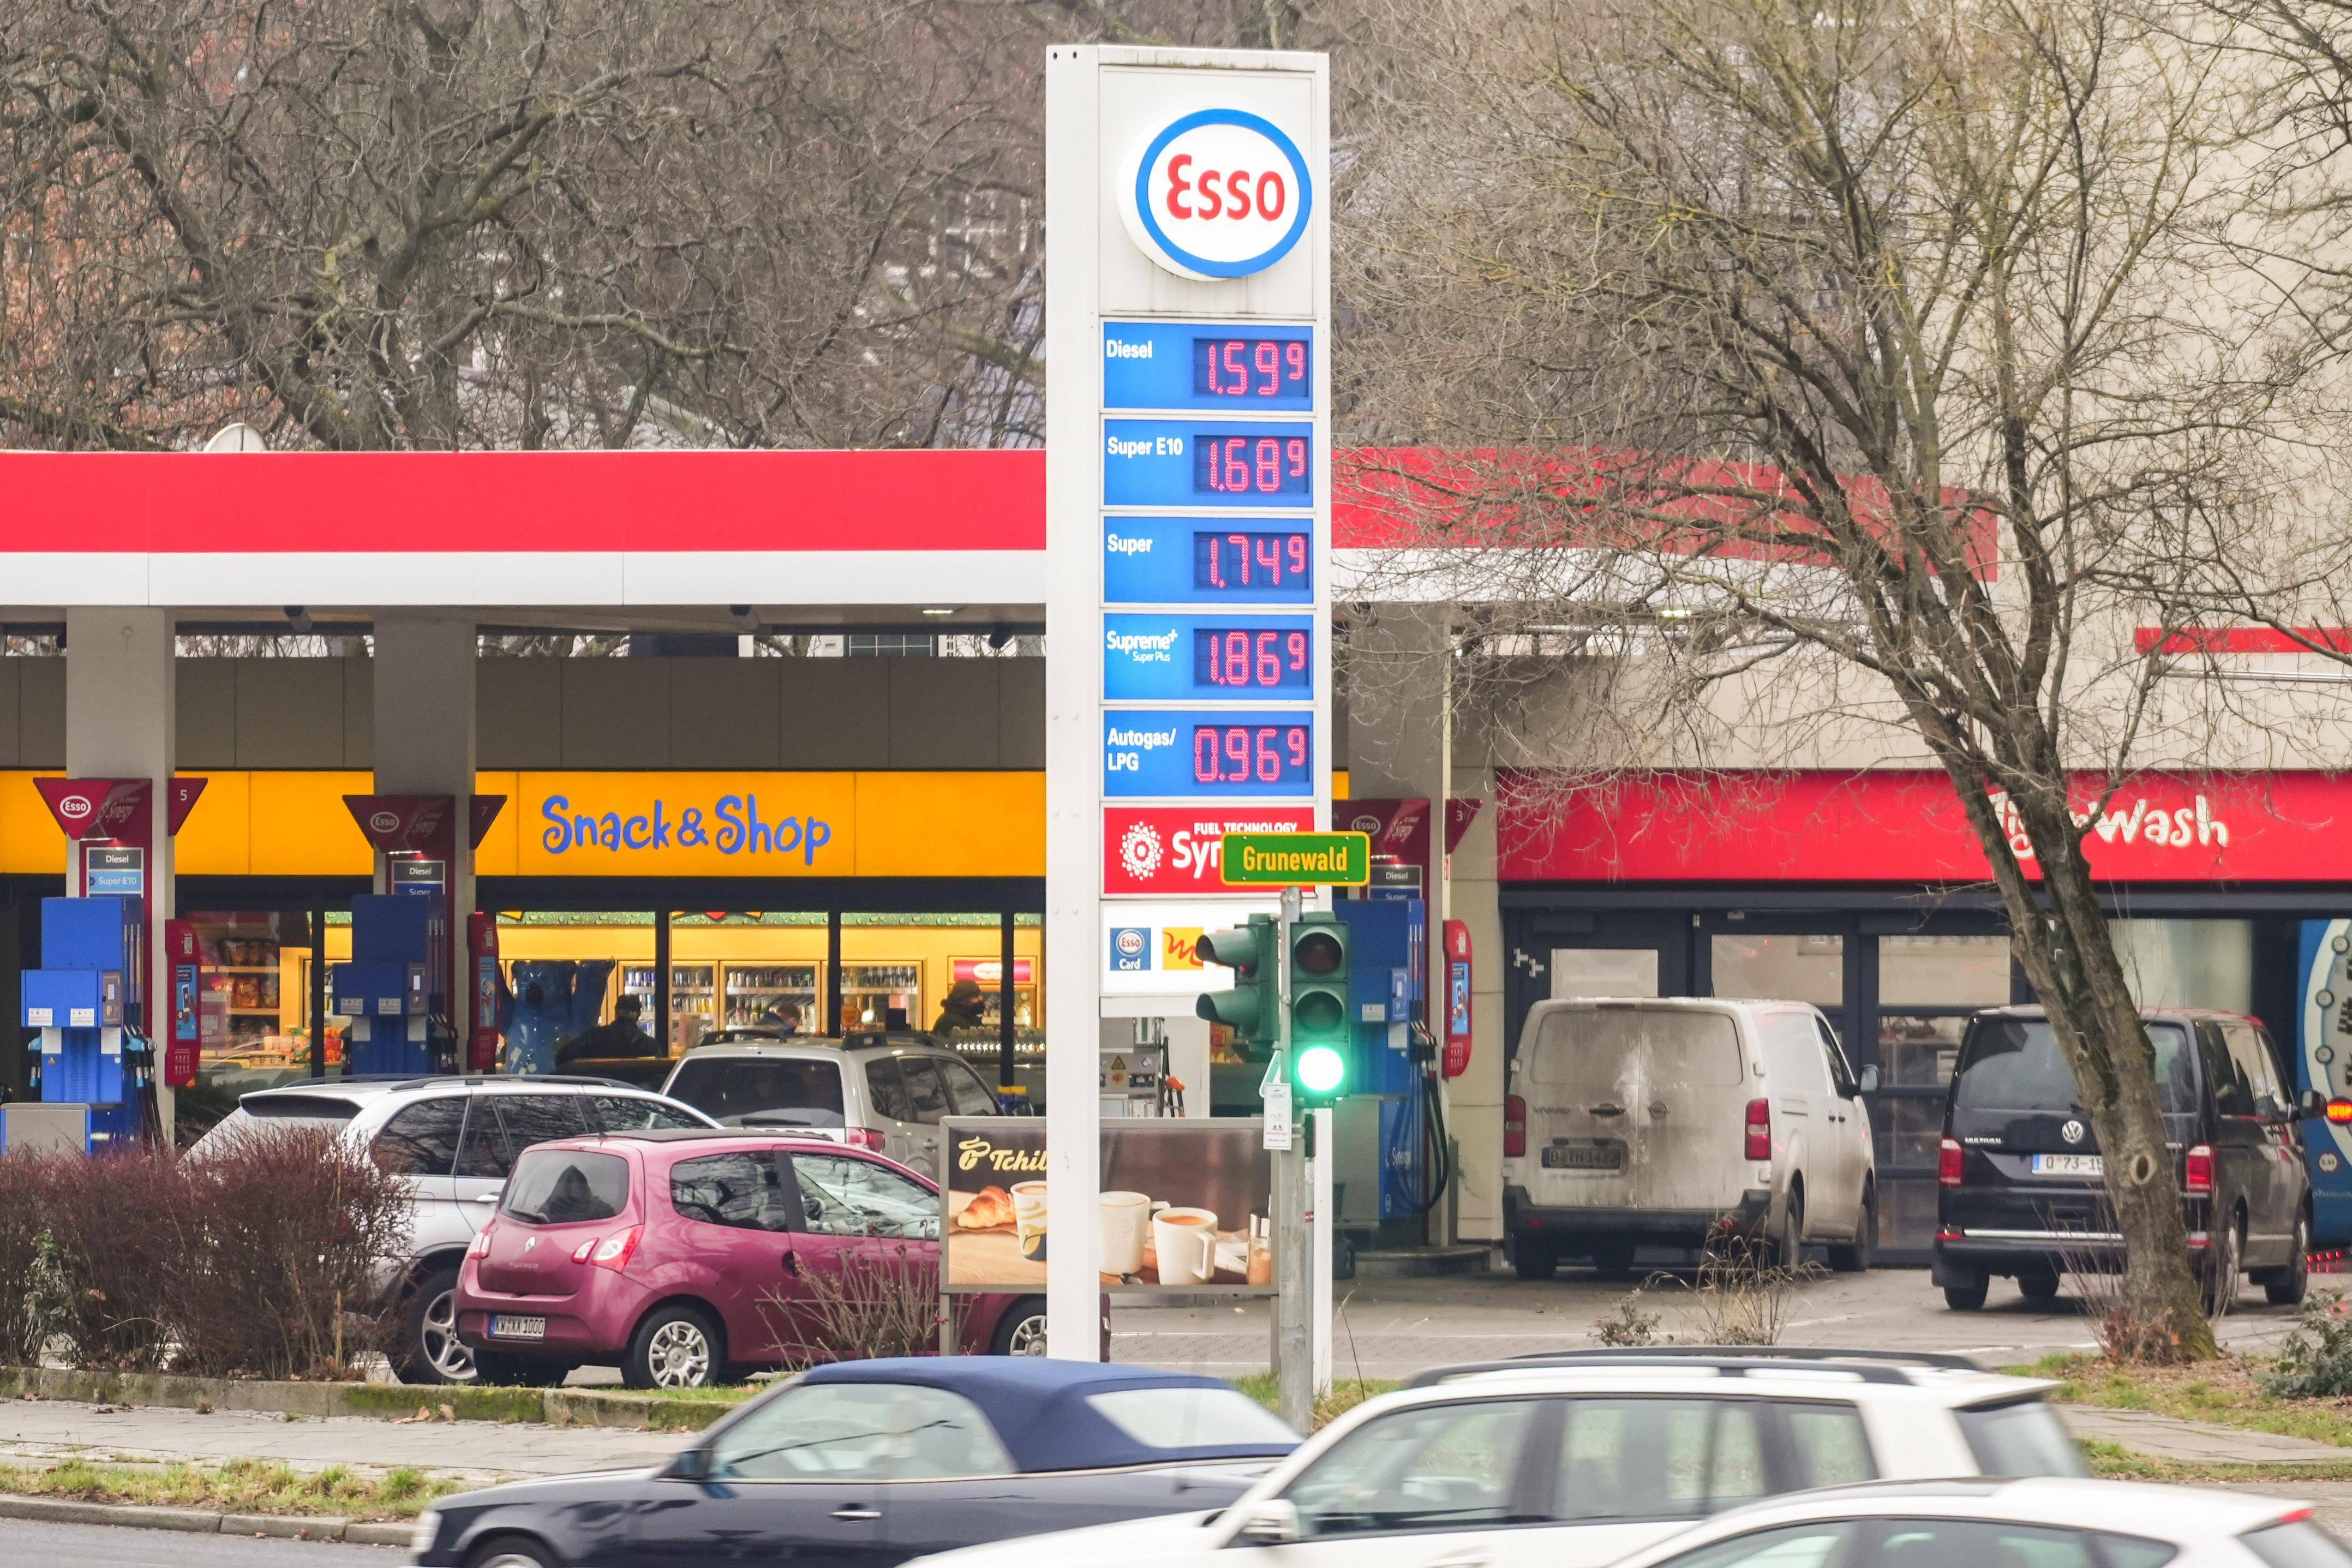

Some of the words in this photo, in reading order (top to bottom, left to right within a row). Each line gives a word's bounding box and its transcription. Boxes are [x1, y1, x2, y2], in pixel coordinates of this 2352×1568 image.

[1166, 153, 1285, 221] Esso
[1106, 339, 1152, 358] Diesel
[1208, 340, 1304, 396] 1.599
[1107, 436, 1152, 459] Super
[1156, 437, 1183, 456] E10
[1210, 438, 1306, 493] 1.689
[1107, 533, 1153, 556] Super
[1210, 535, 1306, 588] 1.749
[1106, 629, 1178, 654] Supreme+
[1210, 631, 1306, 686] 1.869
[1132, 651, 1154, 662] Super
[1155, 651, 1171, 662] Plus
[1107, 728, 1177, 750] Autogas/
[1194, 728, 1306, 782] 0.969
[1108, 753, 1139, 771] LPG
[180, 789, 188, 801] 5
[64, 800, 87, 812] Esso
[480, 806, 488, 816] 7
[374, 816, 396, 827] Esso
[1456, 810, 1463, 821] 3
[542, 794, 672, 854] Snack
[715, 794, 831, 866] Shop
[1194, 822, 1222, 835] FUEL
[1224, 822, 1297, 833] TECHNOLOGY
[1355, 820, 1376, 829] Esso
[105, 854, 129, 863] Diesel
[1242, 846, 1348, 872] Grunewald
[1385, 871, 1409, 879] Diesel
[98, 876, 121, 887] Super
[1121, 937, 1140, 947] Esso
[1118, 958, 1142, 970] Card
[989, 1149, 1047, 1171] Tchi
[523, 1319, 544, 1334] 1000
